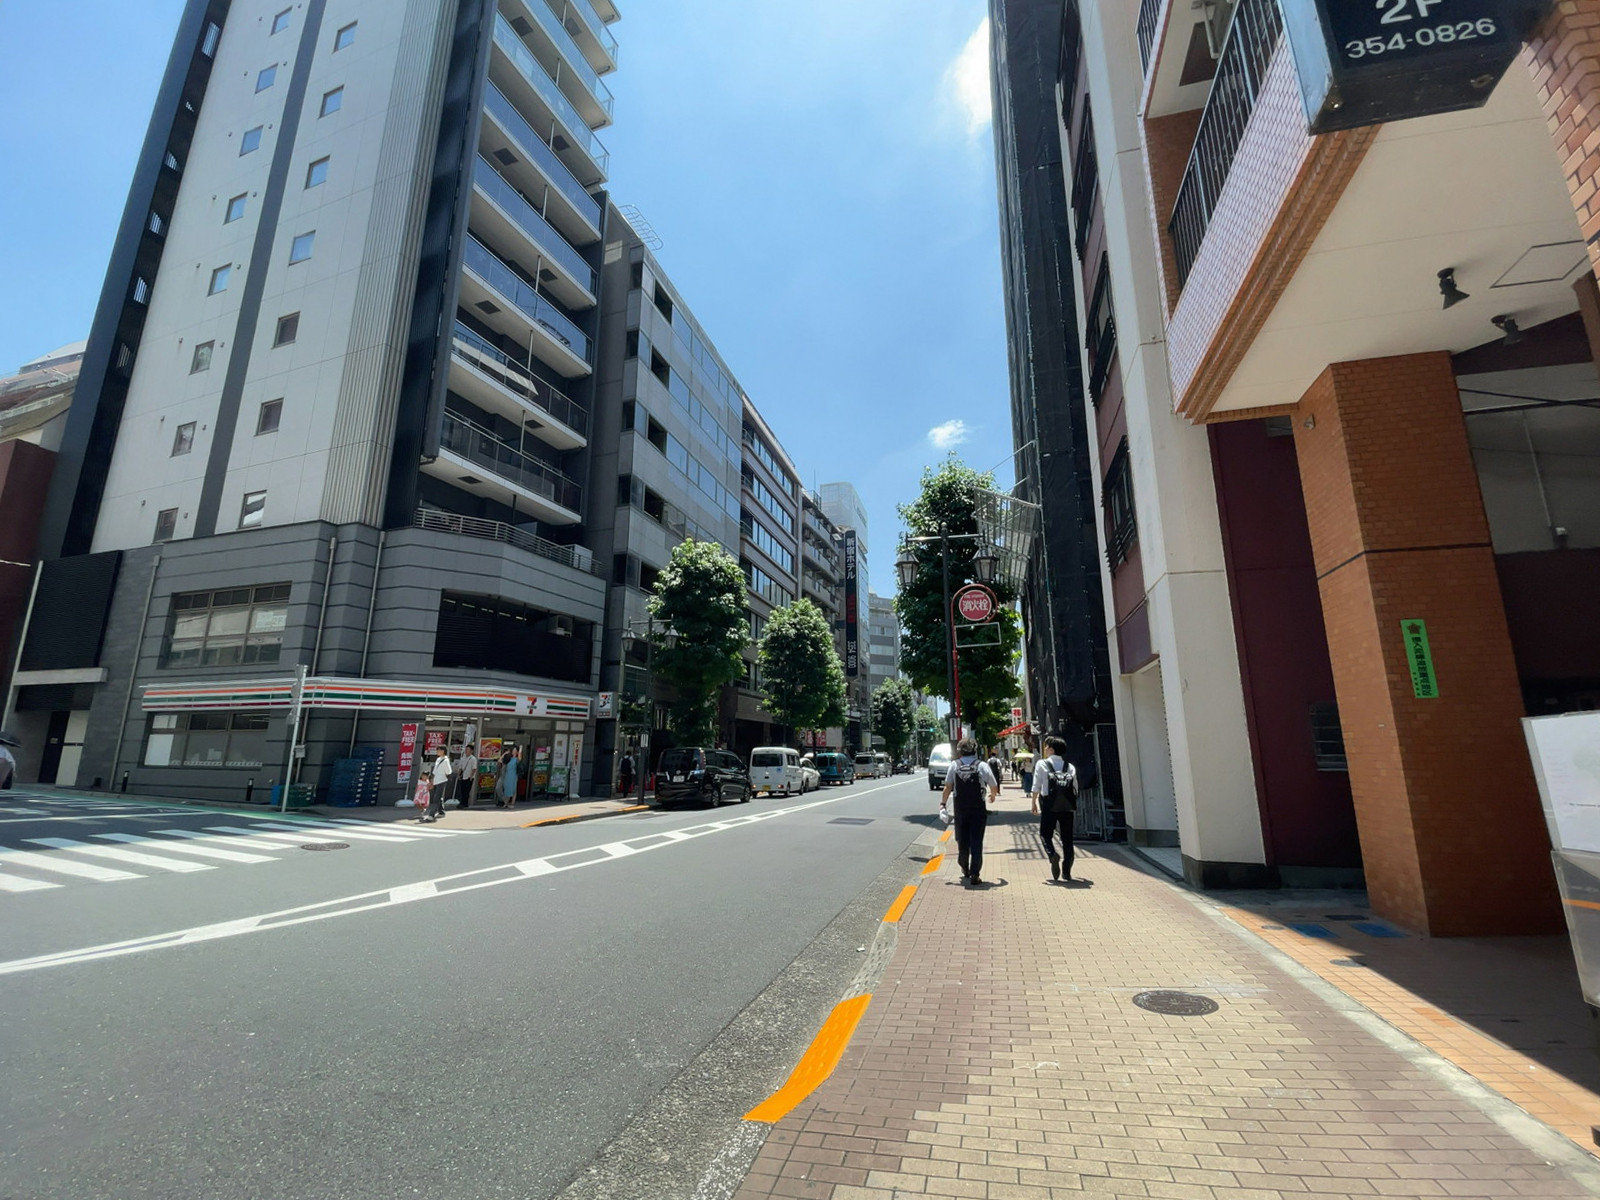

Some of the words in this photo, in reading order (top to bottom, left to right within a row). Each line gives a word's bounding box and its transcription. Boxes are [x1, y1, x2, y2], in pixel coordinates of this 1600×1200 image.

[1345, 18, 1496, 58] 354-0826
[963, 599, 989, 611] 消火栓
